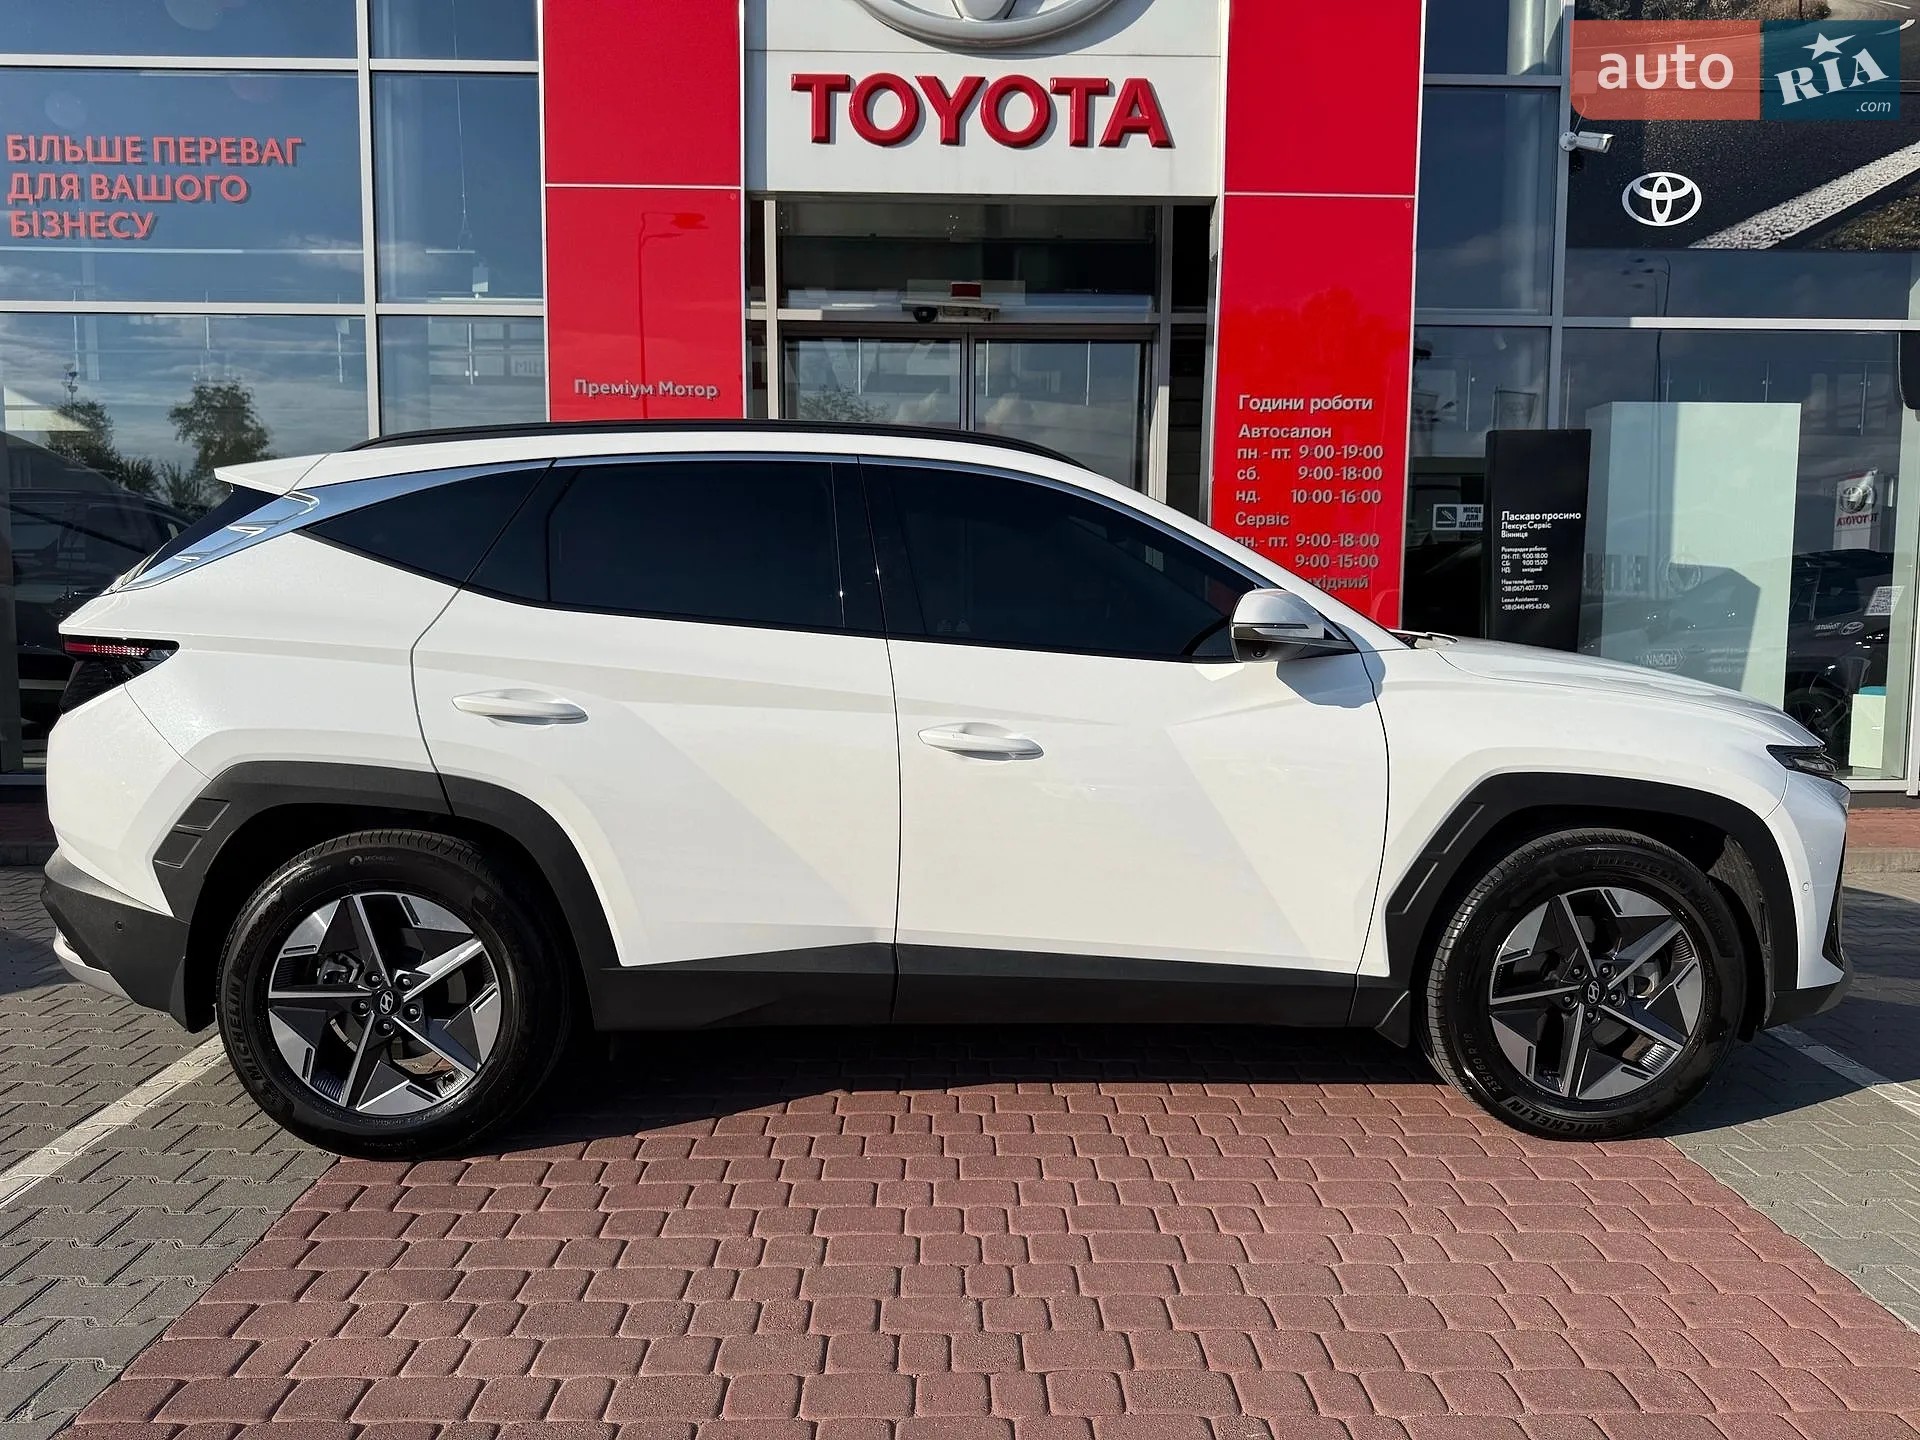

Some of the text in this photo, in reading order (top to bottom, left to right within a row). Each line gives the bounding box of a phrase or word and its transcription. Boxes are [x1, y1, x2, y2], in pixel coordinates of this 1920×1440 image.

[791, 73, 1173, 148] TOYOTA
[6, 134, 303, 165] БІЛЬШЕ ПЕРЕВАГ
[8, 173, 248, 204] ДЛЯ ВАШОГО
[11, 210, 153, 238] БІЗНЕСУ
[574, 379, 718, 399] Преміум Мотор
[1238, 395, 1373, 413] Години роботи
[1238, 424, 1332, 438] Автосалон
[1299, 445, 1384, 459] 9:00-19:00
[1237, 466, 1383, 480] сб. 9:00-18:00
[1236, 489, 1381, 504] нд. 10:00-16:00
[1235, 511, 1290, 527] Сервіс
[1501, 511, 1581, 522] Ласкаво просимо
[1527, 521, 1552, 530] Сервіс
[1295, 533, 1380, 547] 9:00-18:00
[1295, 554, 1379, 568] 9:00-15:00
